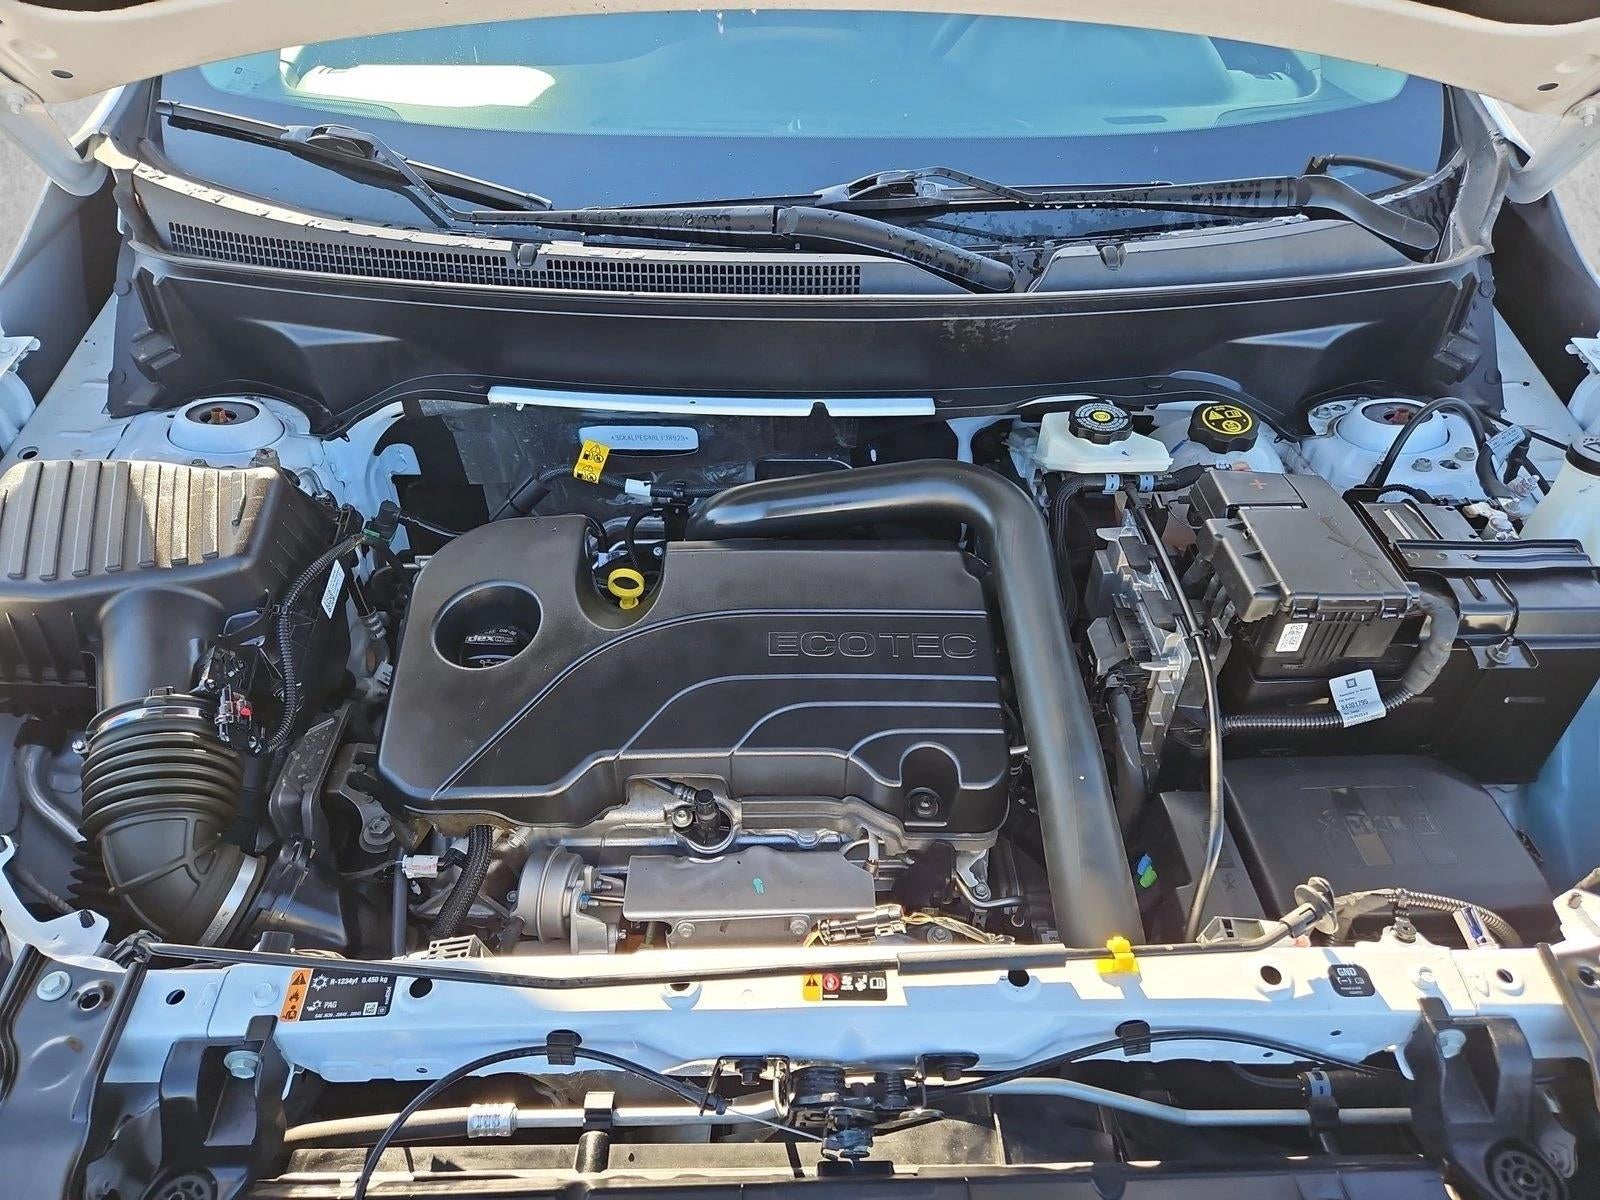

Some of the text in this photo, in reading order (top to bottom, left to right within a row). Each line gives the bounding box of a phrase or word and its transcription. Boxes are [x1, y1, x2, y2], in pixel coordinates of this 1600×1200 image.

[767, 631, 977, 659] ECOTEC
[1336, 967, 1357, 976] GND
[329, 977, 359, 986] R-1234yf
[361, 976, 379, 984] 0.450
[323, 1001, 338, 1009] PAG
